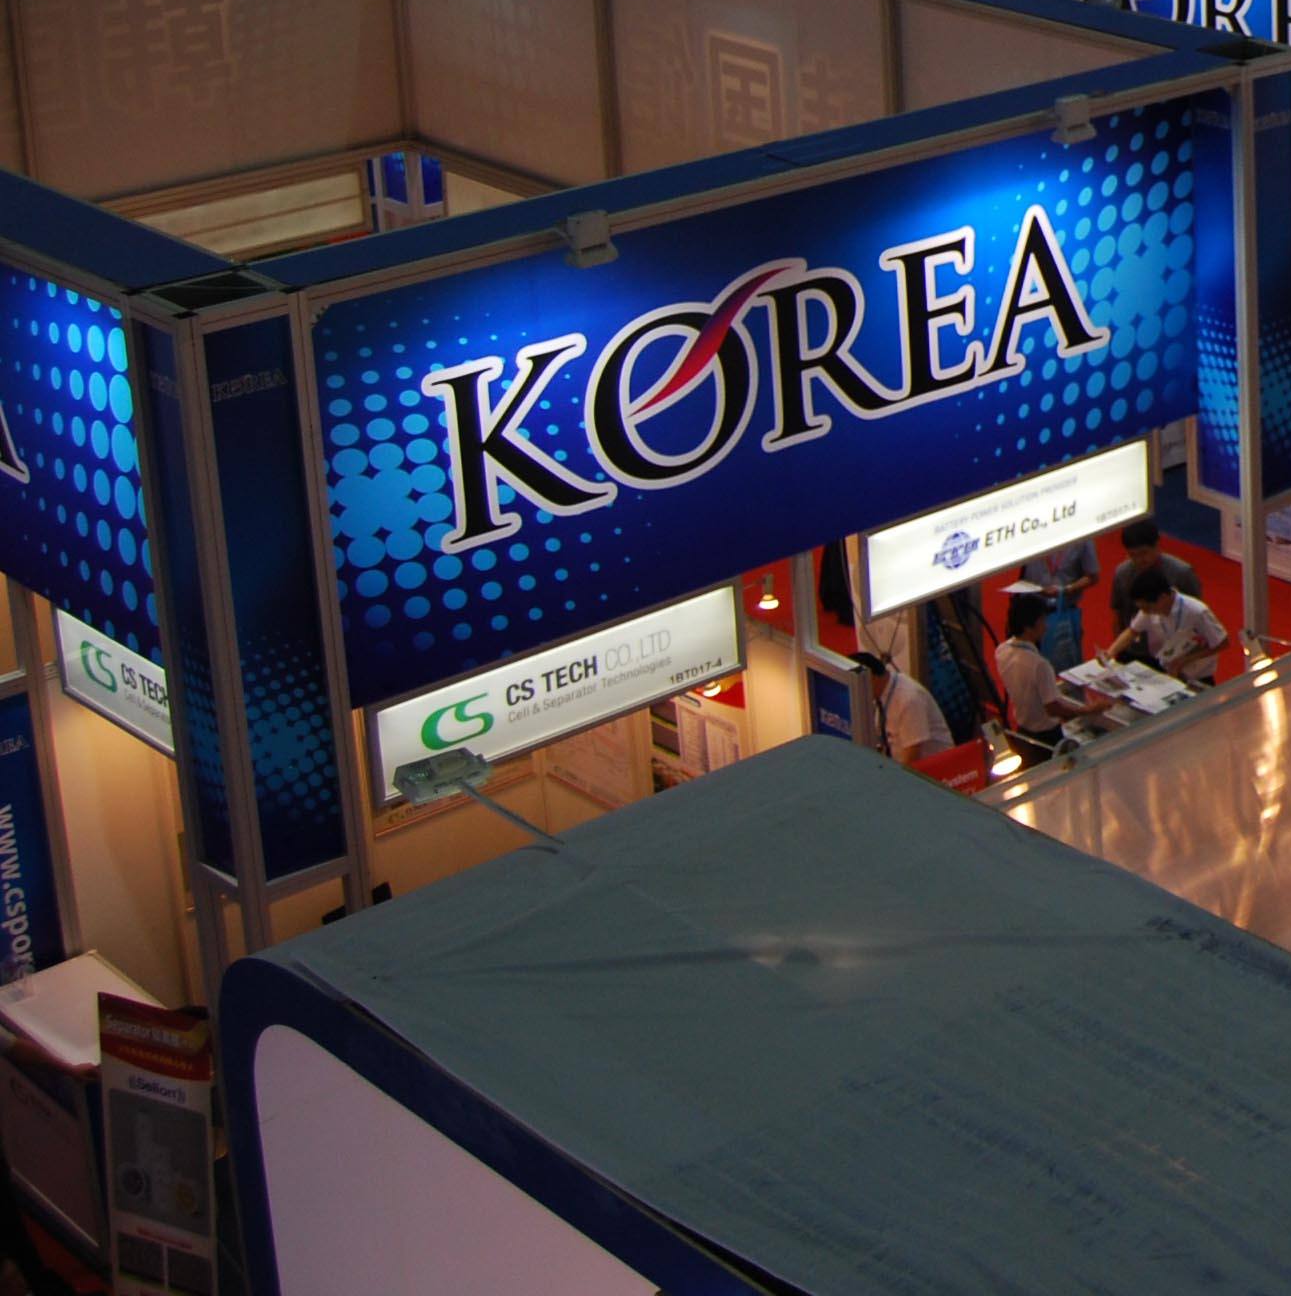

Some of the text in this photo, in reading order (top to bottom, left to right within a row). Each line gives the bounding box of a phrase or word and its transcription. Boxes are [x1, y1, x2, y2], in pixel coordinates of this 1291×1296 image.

[422, 205, 1109, 555] KOREA
[985, 523, 1017, 548] ETH
[1052, 500, 1077, 523] Ltd
[120, 661, 139, 692] CS
[506, 678, 535, 707] CS
[541, 655, 599, 694] TECH
[508, 707, 531, 724] Cell
[543, 683, 598, 713] Separator
[601, 655, 673, 690] Technologies
